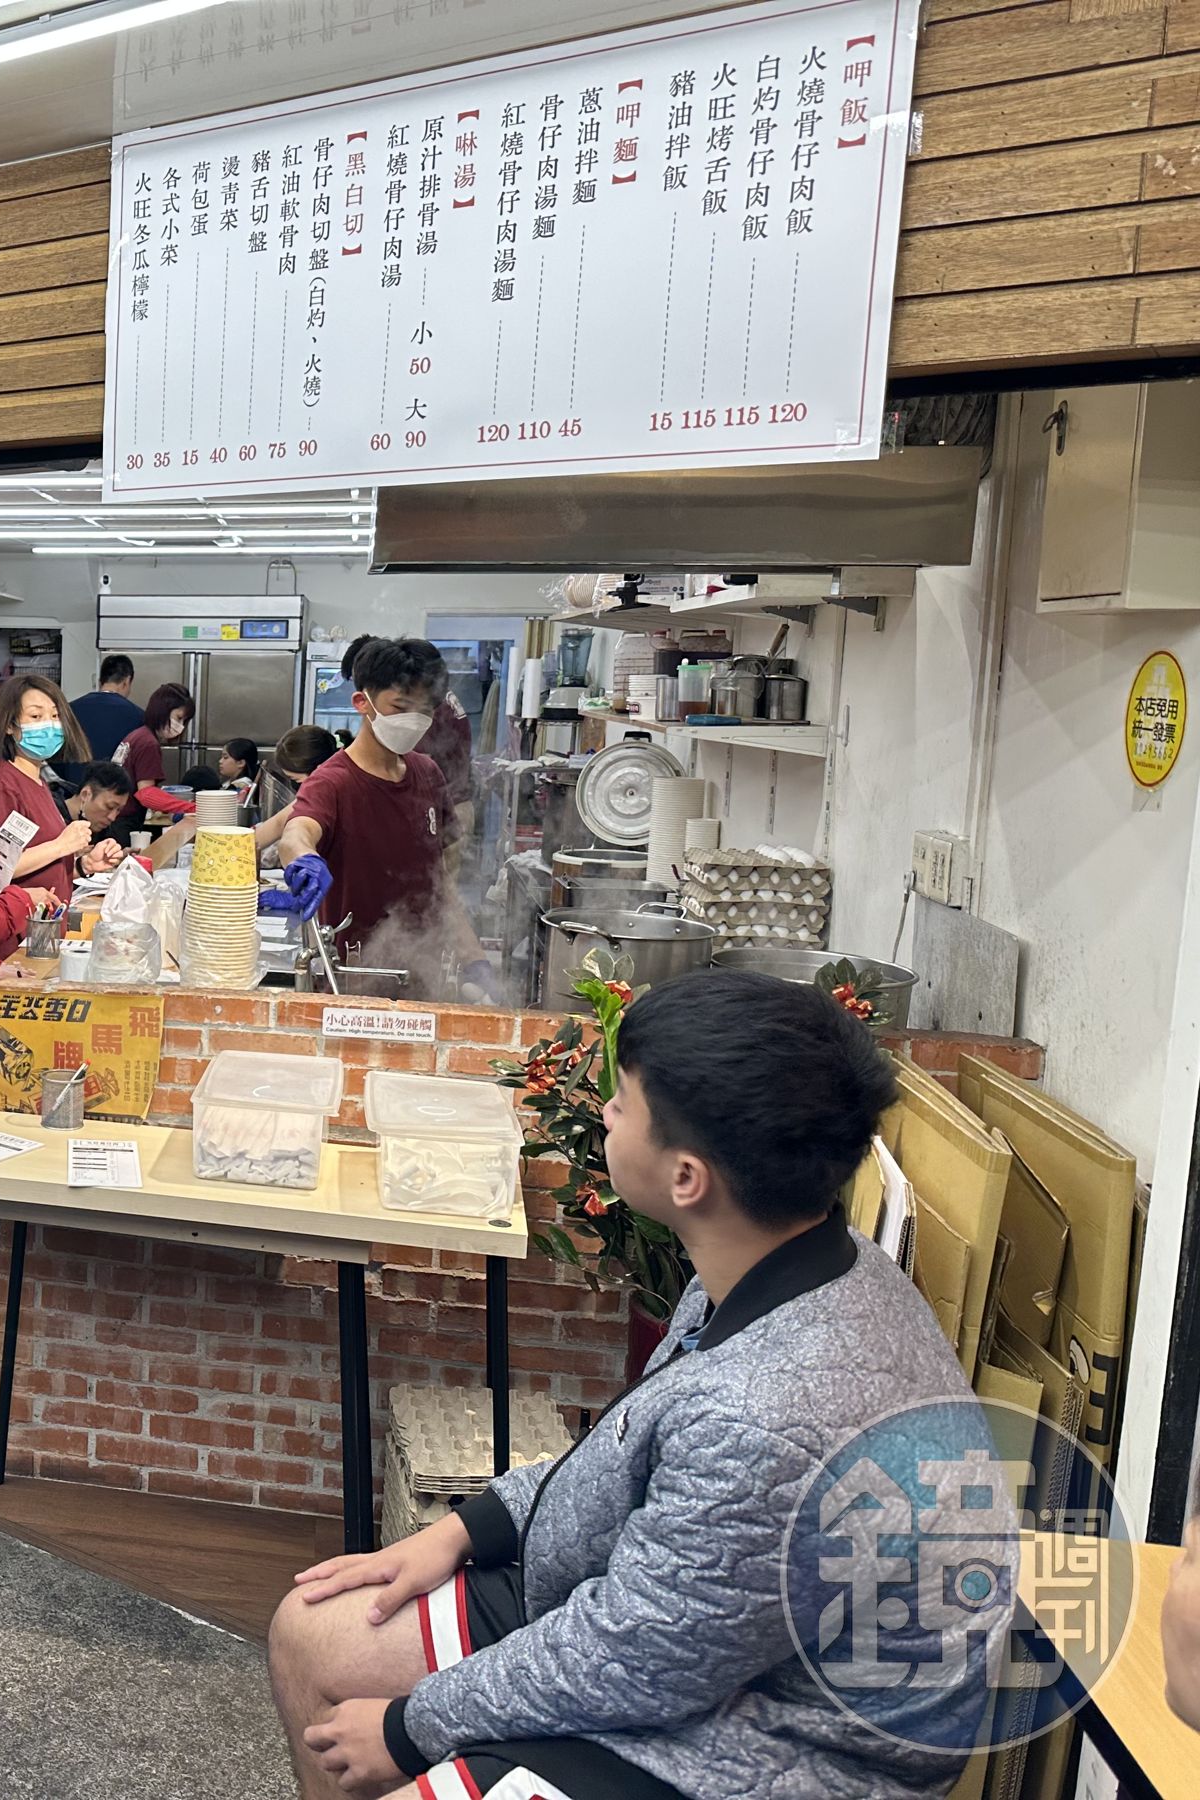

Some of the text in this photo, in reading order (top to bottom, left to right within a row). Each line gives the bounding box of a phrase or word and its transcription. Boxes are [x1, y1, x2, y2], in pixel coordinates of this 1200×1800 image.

[127, 172, 152, 470] 火旺冬瓜檸檬 30
[154, 167, 181, 468] 各式小菜 35
[181, 162, 211, 466] 荷包蛋 15
[210, 156, 241, 464] 燙青菜 40
[238, 151, 271, 461] 豬舌切盤 60
[268, 145, 302, 459] 紅油軟骨肉 75
[370, 125, 410, 451] 紅燒骨仔肉湯 60
[405, 116, 445, 448] 原汁排骨湯 小 50 大 90
[477, 102, 526, 443] 紅燒骨仔肉湯麵 120
[518, 94, 564, 440] 骨仔肉湯麵 110
[558, 87, 603, 437] 蔥油拌麵 45
[650, 70, 696, 431] 豬油拌飯 15
[681, 63, 737, 428] 火旺烤舌飯 115
[724, 55, 781, 426] 白灼骨仔肉飯 115
[768, 46, 827, 423] 火燒骨仔肉飯 120
[299, 440, 317, 456] 90
[1131, 717, 1176, 743] 統一發票
[1134, 696, 1179, 719] 本店免用
